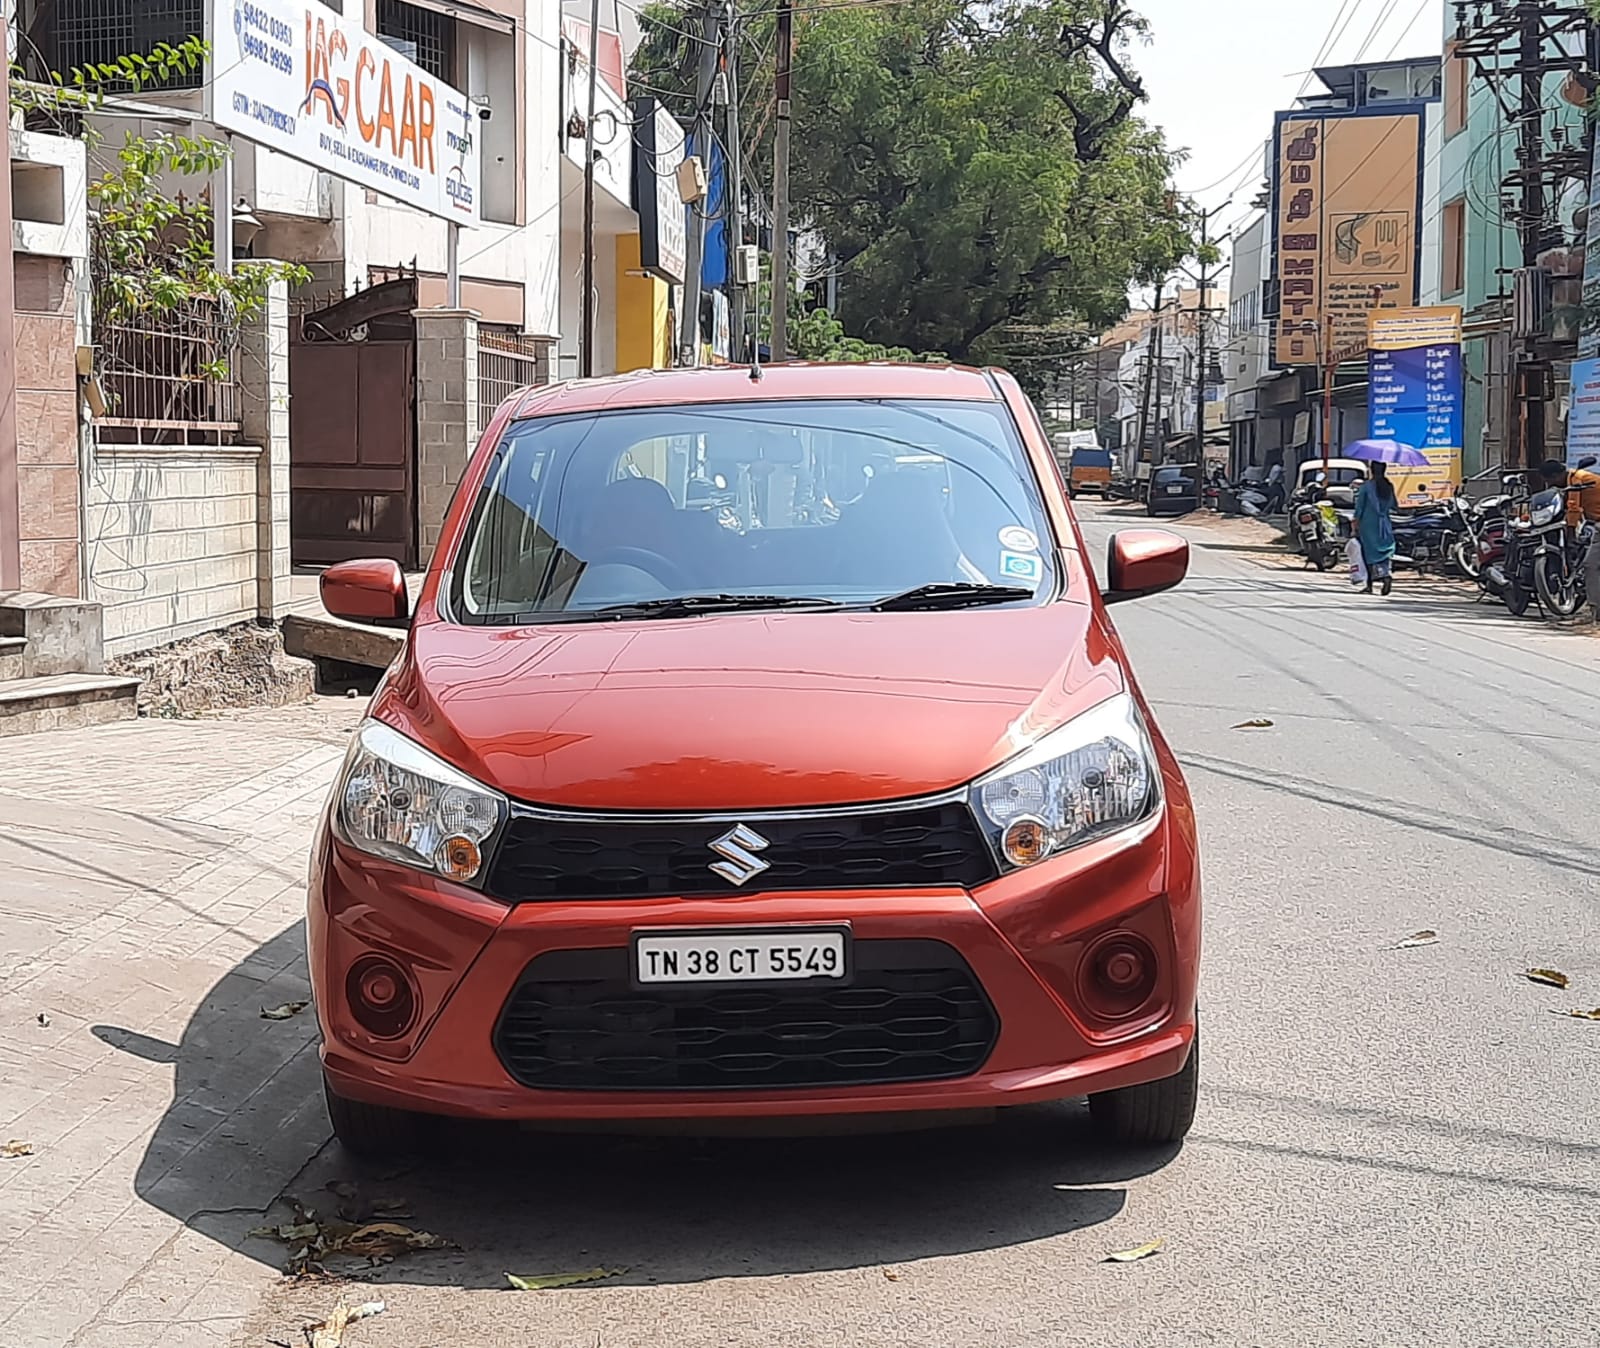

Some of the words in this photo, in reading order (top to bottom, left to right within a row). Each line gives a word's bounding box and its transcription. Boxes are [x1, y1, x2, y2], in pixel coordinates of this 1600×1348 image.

[243, 1, 268, 34] 98422
[270, 17, 292, 47] 03953
[243, 31, 268, 63] 96982
[270, 46, 292, 76] 99299
[355, 46, 435, 175] CAAR
[333, 141, 347, 160] SELL
[645, 950, 678, 975] TN
[687, 950, 719, 974] 38
[729, 949, 759, 973] CT
[769, 947, 837, 973] 5549
